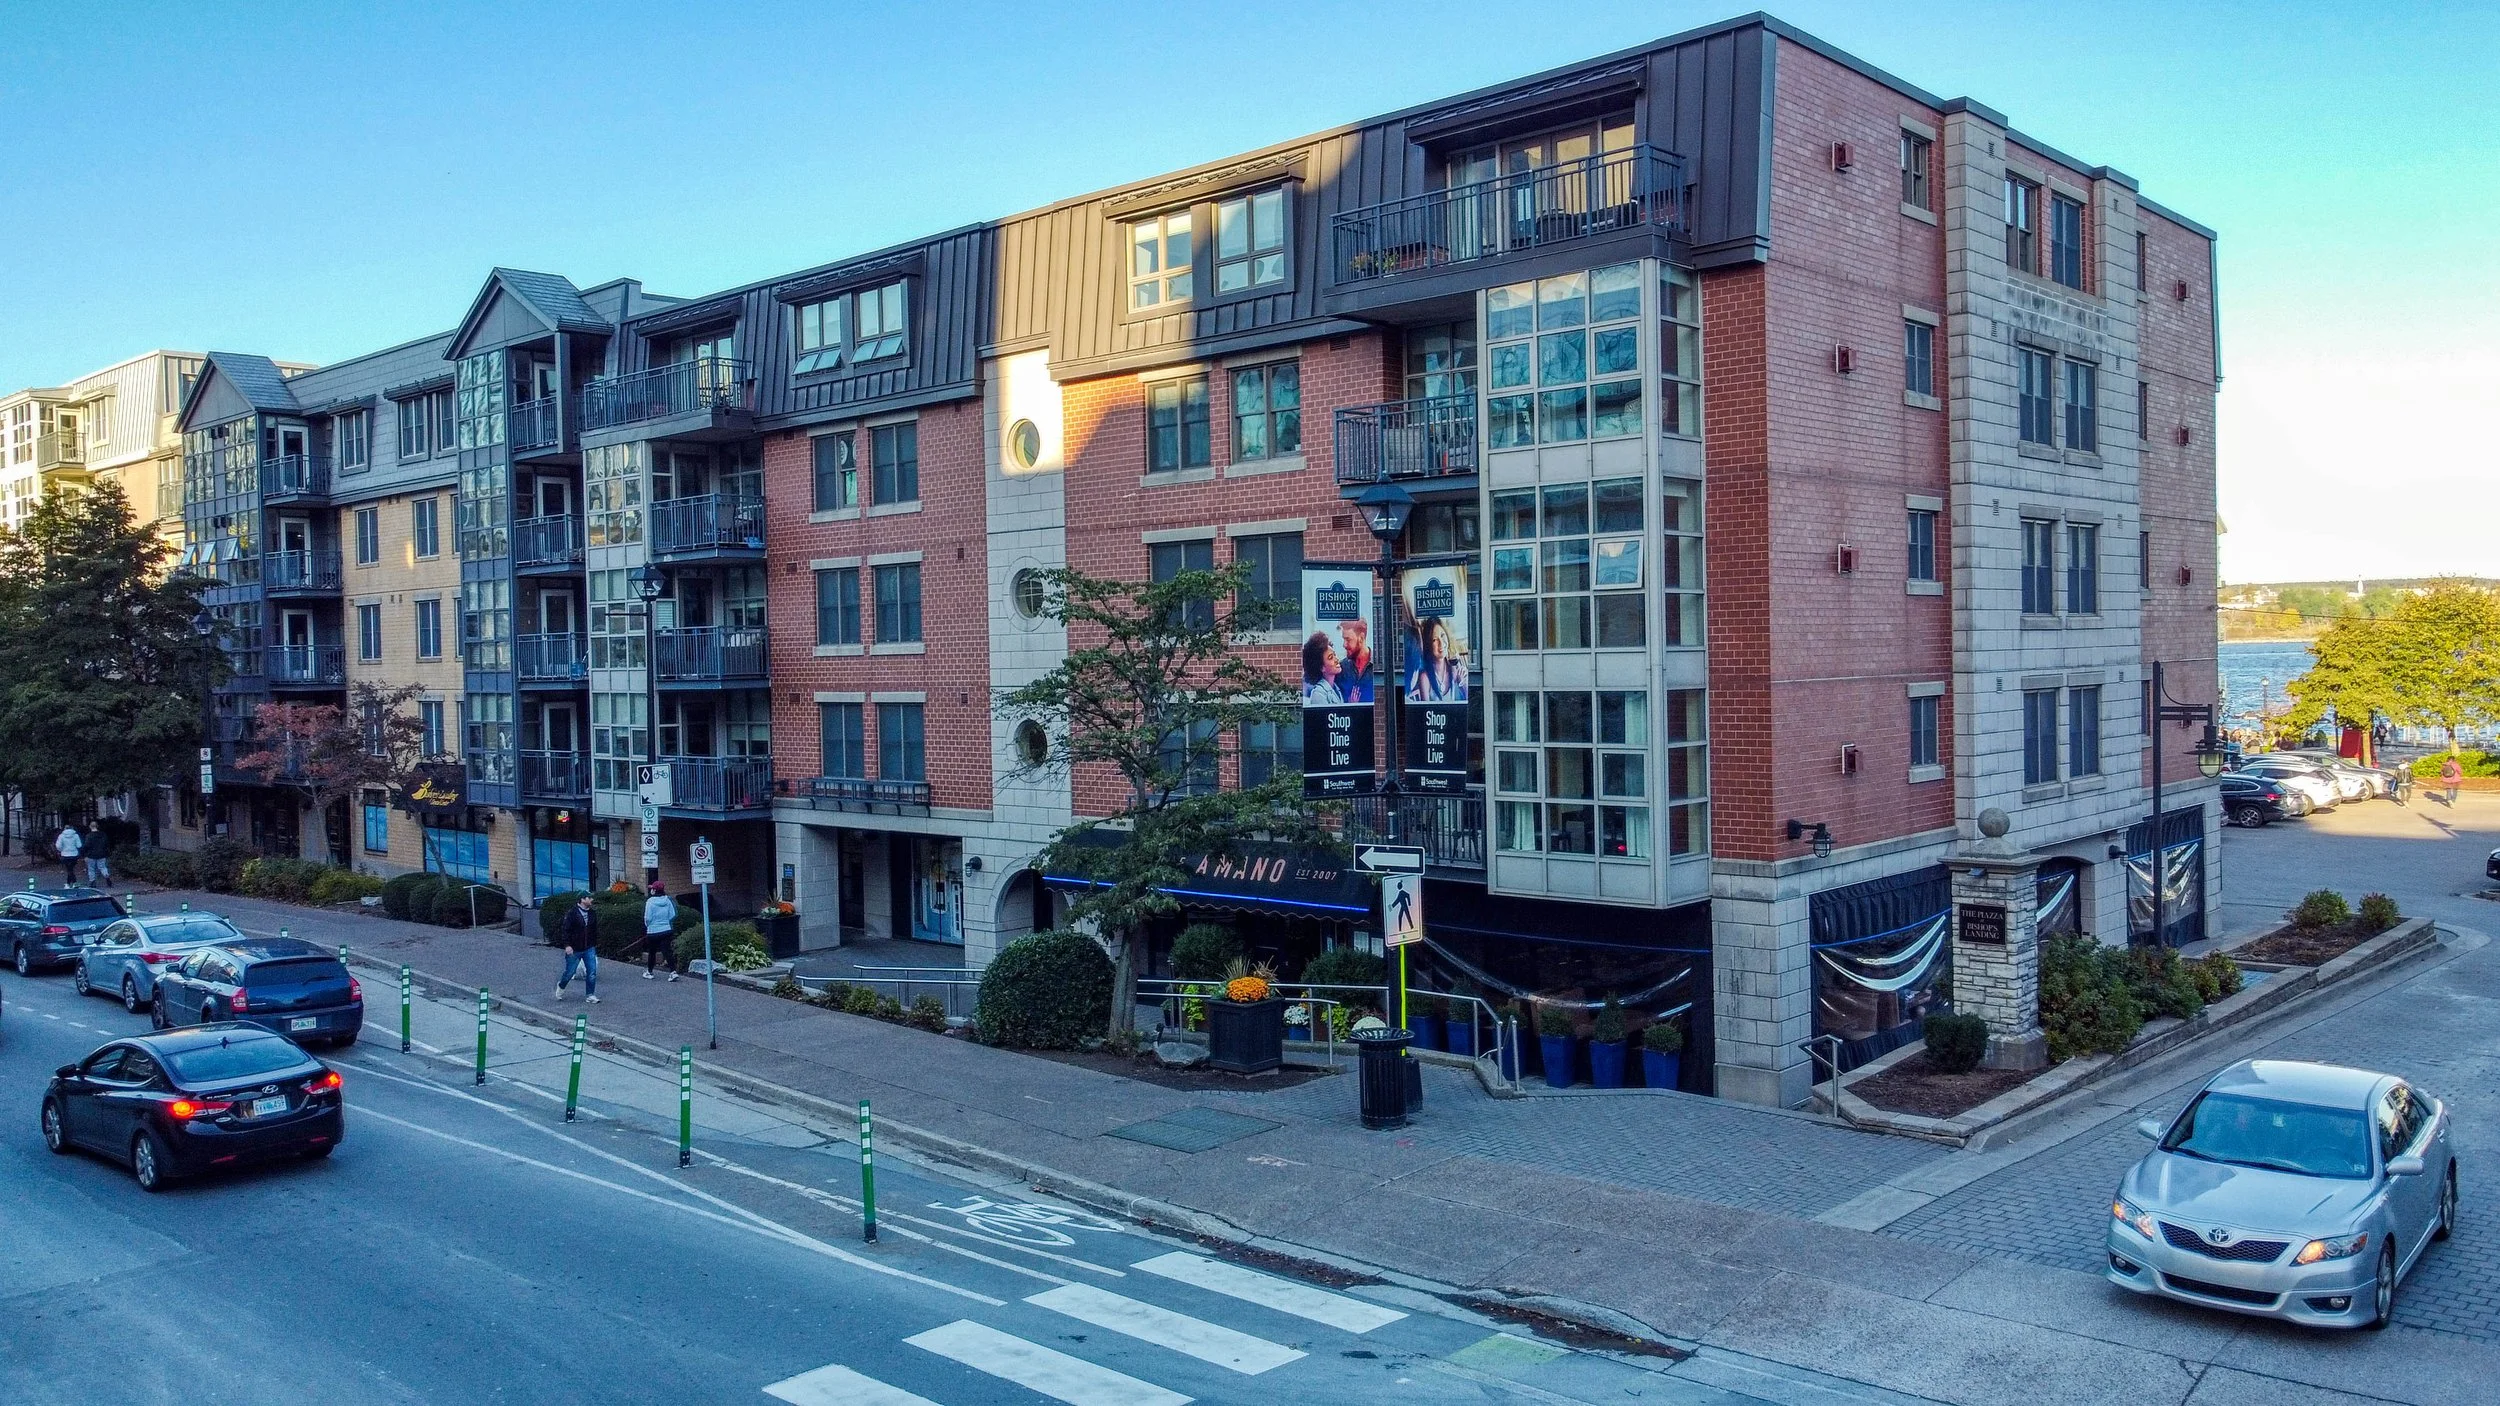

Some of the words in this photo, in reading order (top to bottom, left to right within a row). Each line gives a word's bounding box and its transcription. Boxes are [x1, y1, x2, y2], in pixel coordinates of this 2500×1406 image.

[1319, 592, 1357, 601] BISHOP'S
[1416, 589, 1452, 599] BISHOP'S
[1319, 602, 1357, 611] LANDING
[1417, 598, 1452, 609] LANDING
[1328, 713, 1351, 731] Shop
[1426, 710, 1446, 730] Shop
[1329, 731, 1350, 747] Dine
[1427, 729, 1445, 745] Dine
[1330, 750, 1350, 766] Live
[1427, 748, 1444, 763] Live
[1312, 870, 1337, 881] 2007
[1961, 910, 1977, 918] THE
[1965, 929, 2000, 939] LANDING
